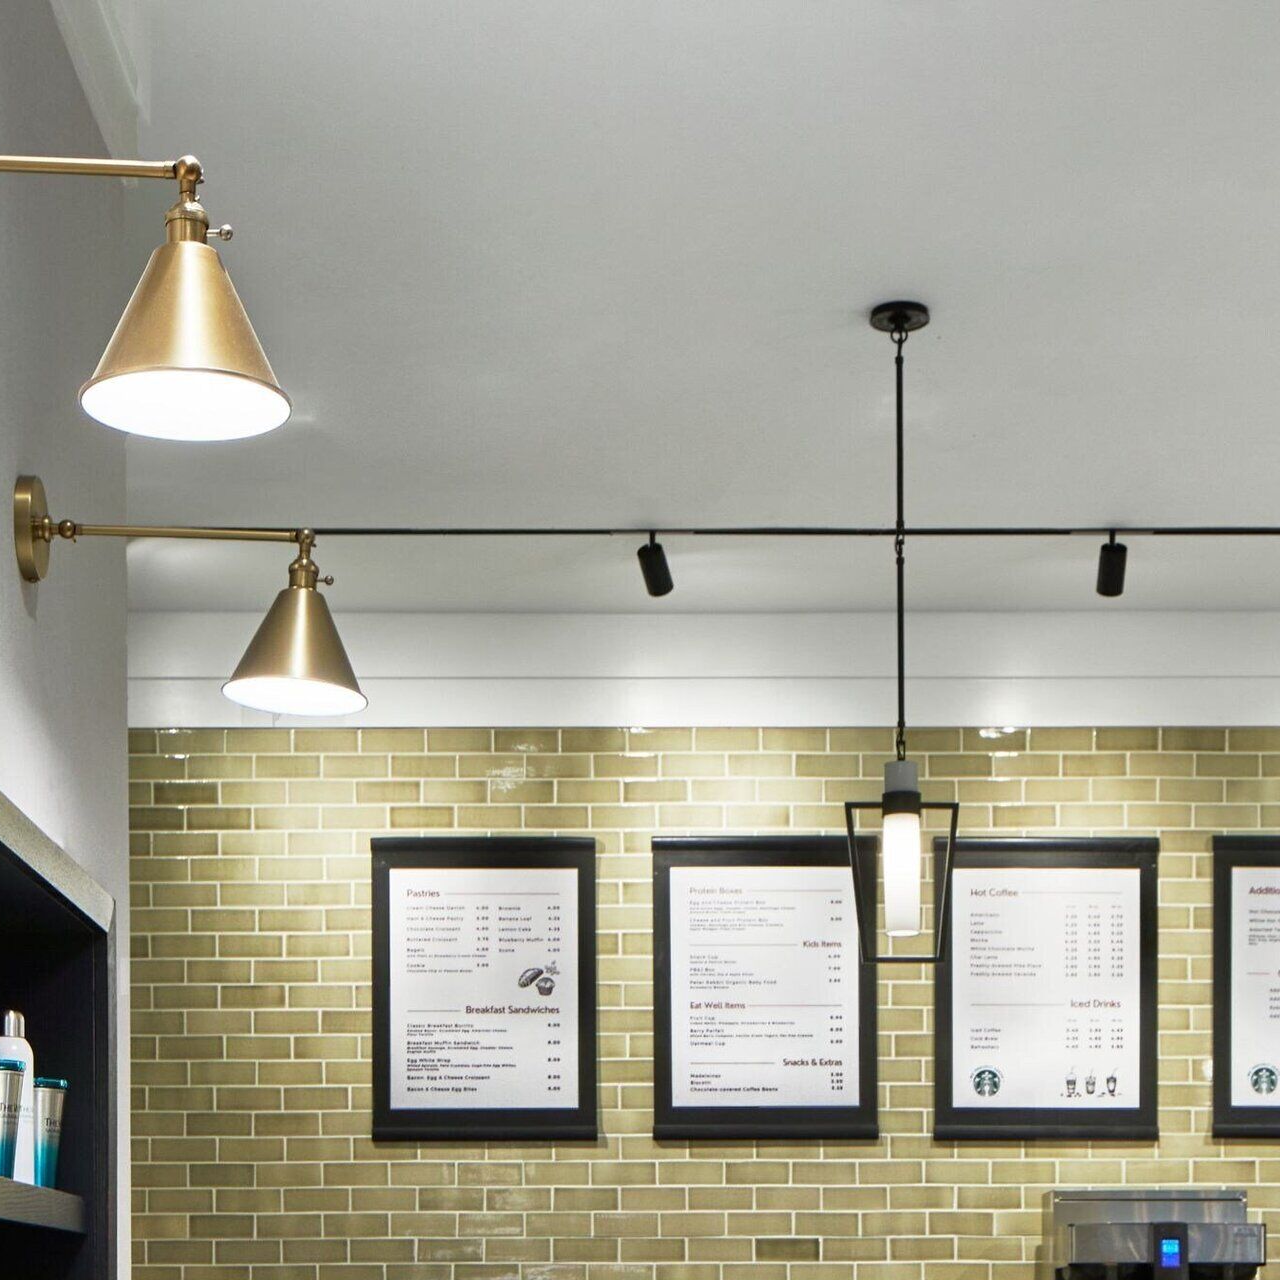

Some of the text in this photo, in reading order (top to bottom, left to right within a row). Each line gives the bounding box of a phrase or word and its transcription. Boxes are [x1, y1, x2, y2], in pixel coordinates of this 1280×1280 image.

[406, 889, 440, 898] Pastries
[689, 887, 742, 895] Protein Boxes
[970, 889, 1019, 897] Hot Coffee
[803, 940, 842, 948] Kids Items
[1070, 1000, 1121, 1008] Iced Drinks
[465, 1005, 560, 1014] Breakfast Sandwiches
[783, 1058, 809, 1066] Snacks
[819, 1058, 843, 1066] Extras
[0, 1102, 14, 1112] THE
